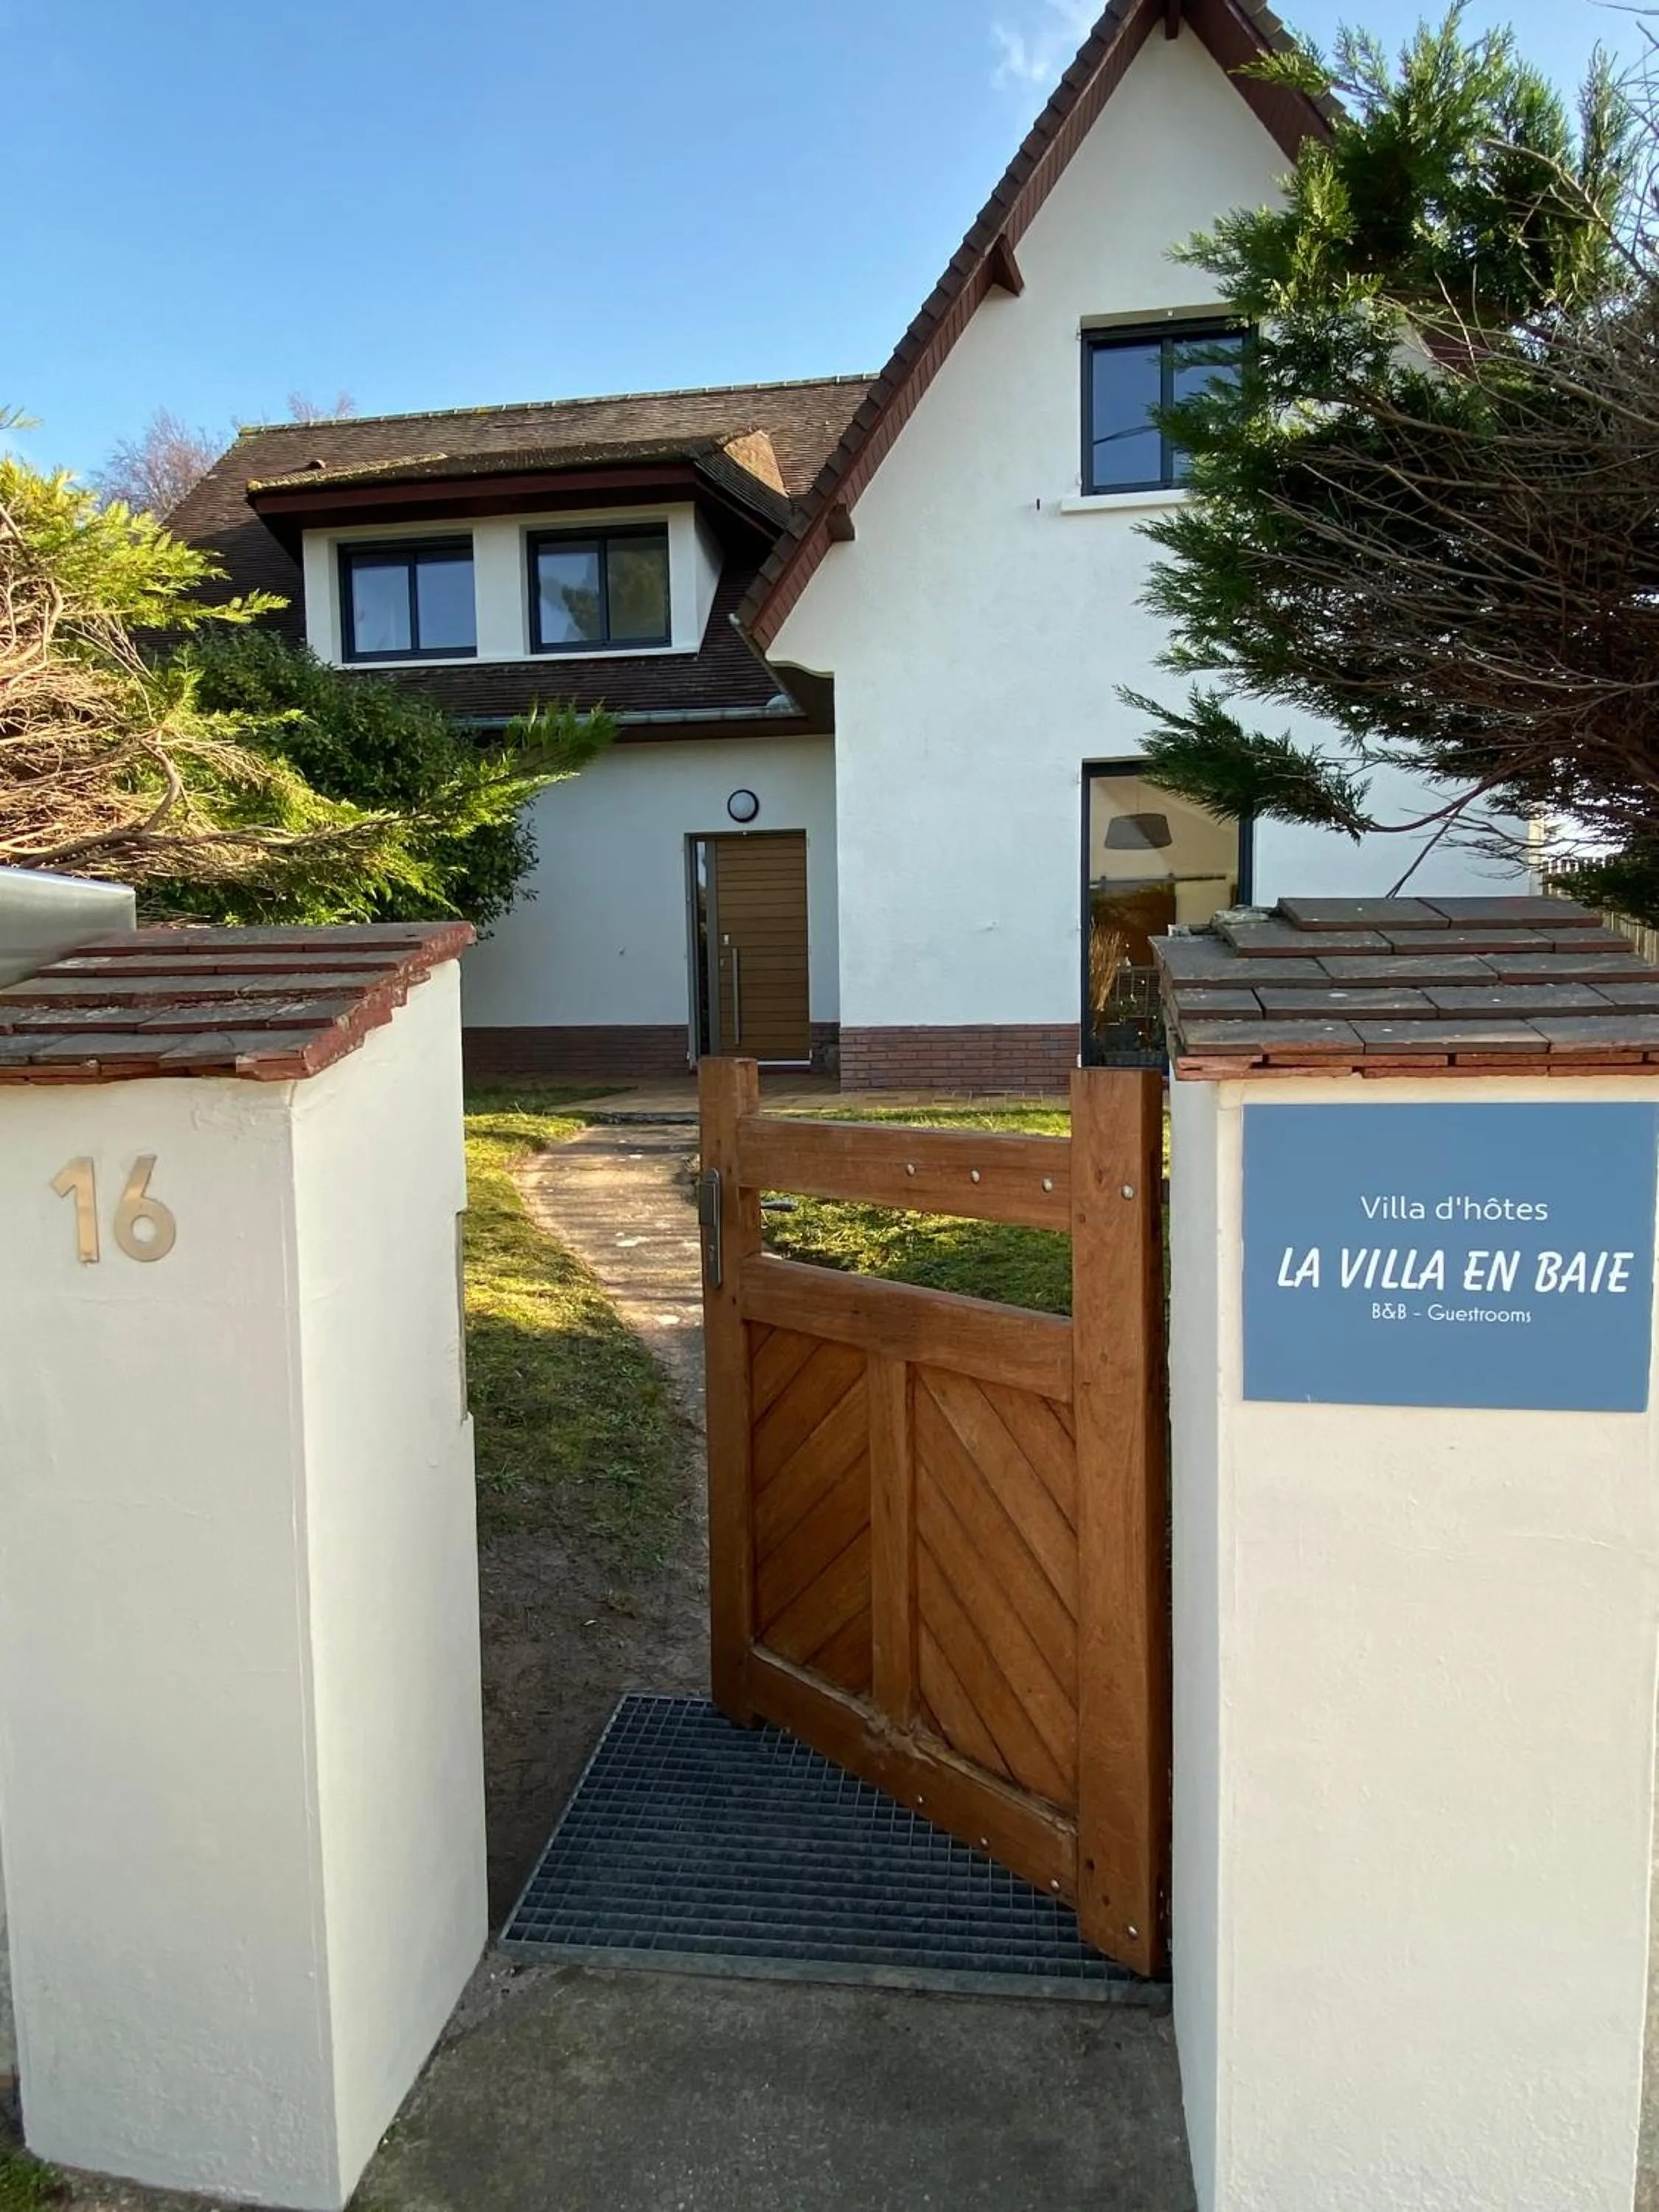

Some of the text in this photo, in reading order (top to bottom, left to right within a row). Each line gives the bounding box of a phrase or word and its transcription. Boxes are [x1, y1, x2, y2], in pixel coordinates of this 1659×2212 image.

[49, 1154, 176, 1264] 16
[1361, 1196, 1548, 1220] Villa d'hôtes
[1277, 1248, 1634, 1293] LA VILLA EN BAIE
[1372, 1303, 1406, 1319] B&B
[1428, 1304, 1531, 1322] Guestrooms
